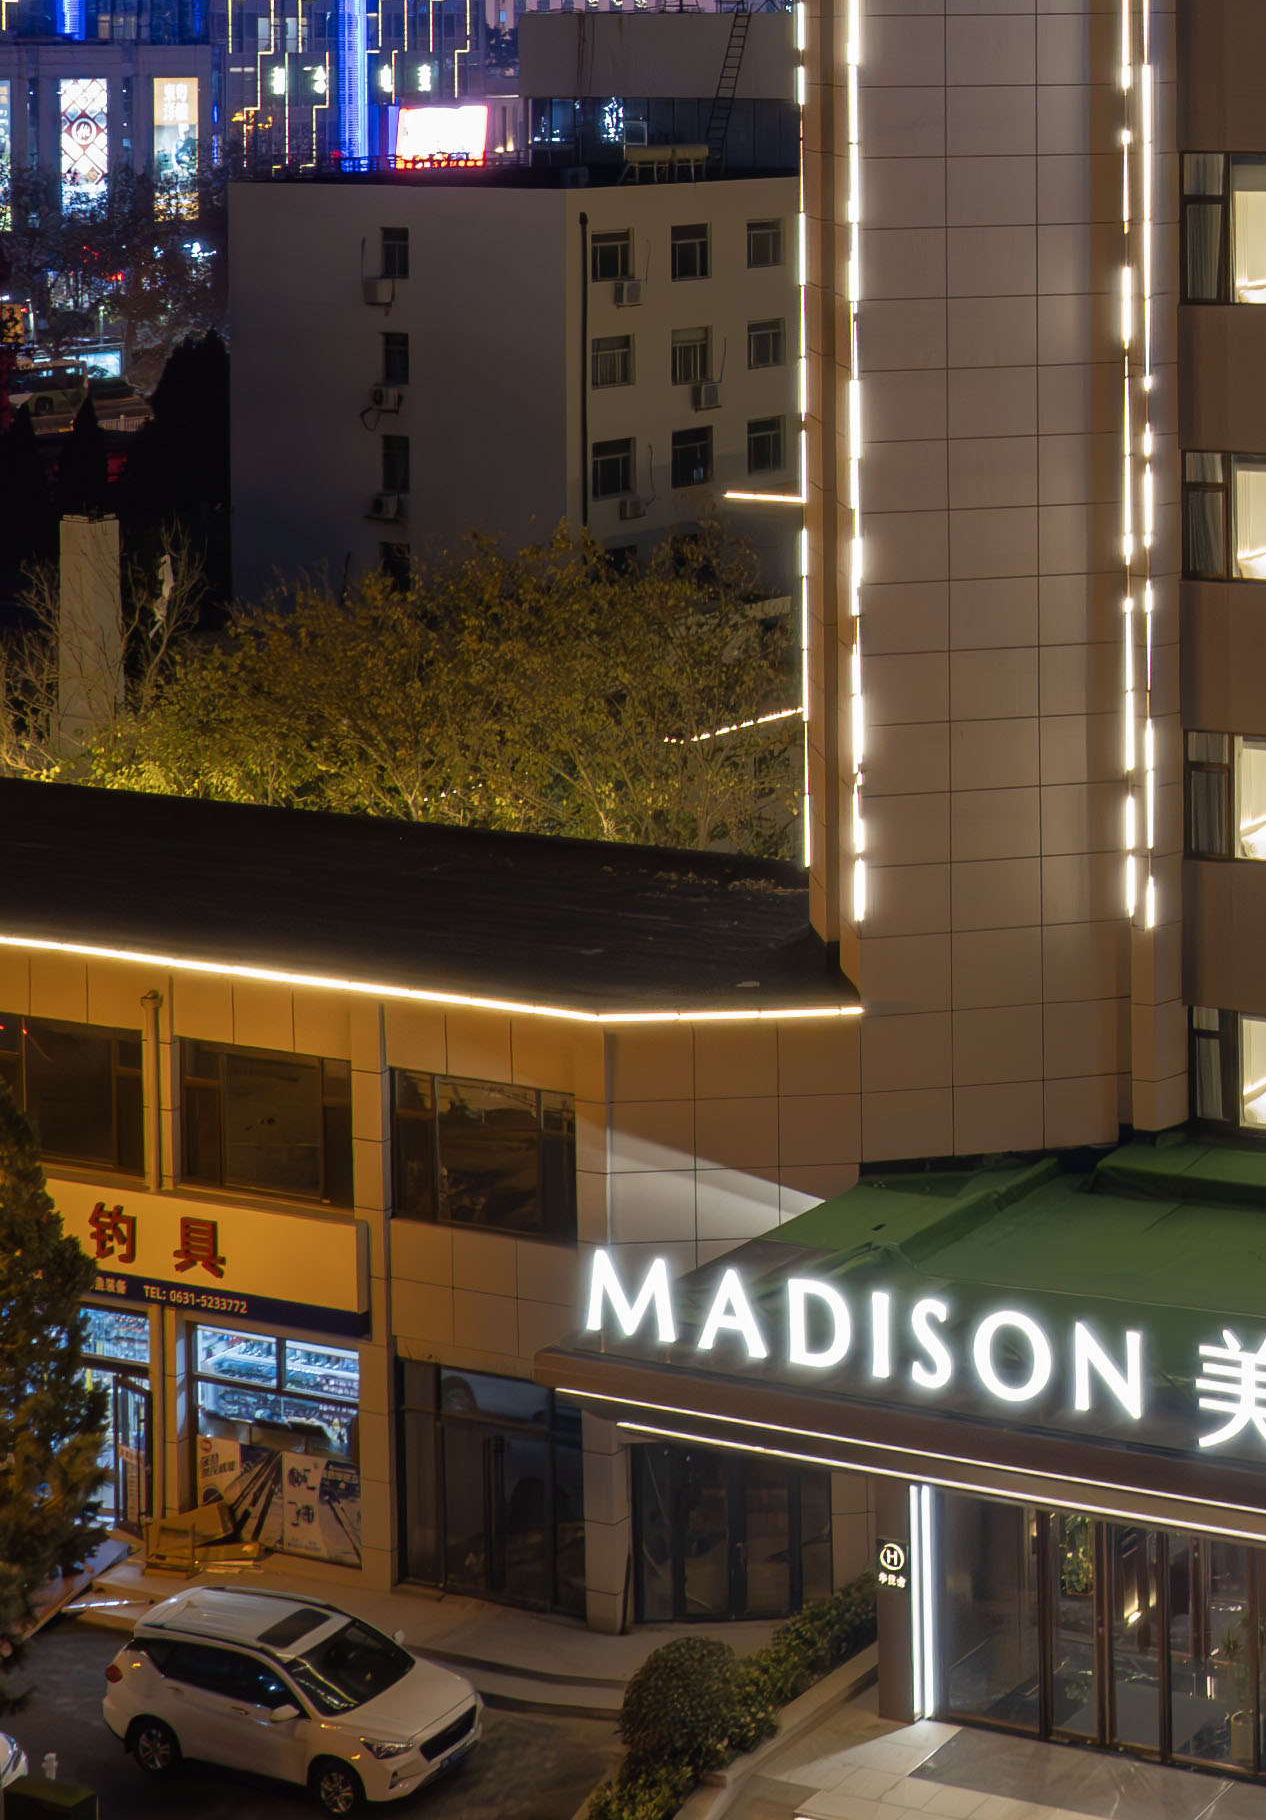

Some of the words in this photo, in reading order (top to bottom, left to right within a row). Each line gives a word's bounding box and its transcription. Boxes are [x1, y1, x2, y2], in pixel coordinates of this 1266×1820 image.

[88, 1201, 226, 1278] 钓具
[144, 1285, 166, 1300] TEL:
[170, 1290, 248, 1313] 0631-5233772
[586, 1249, 1142, 1419] MADISON
